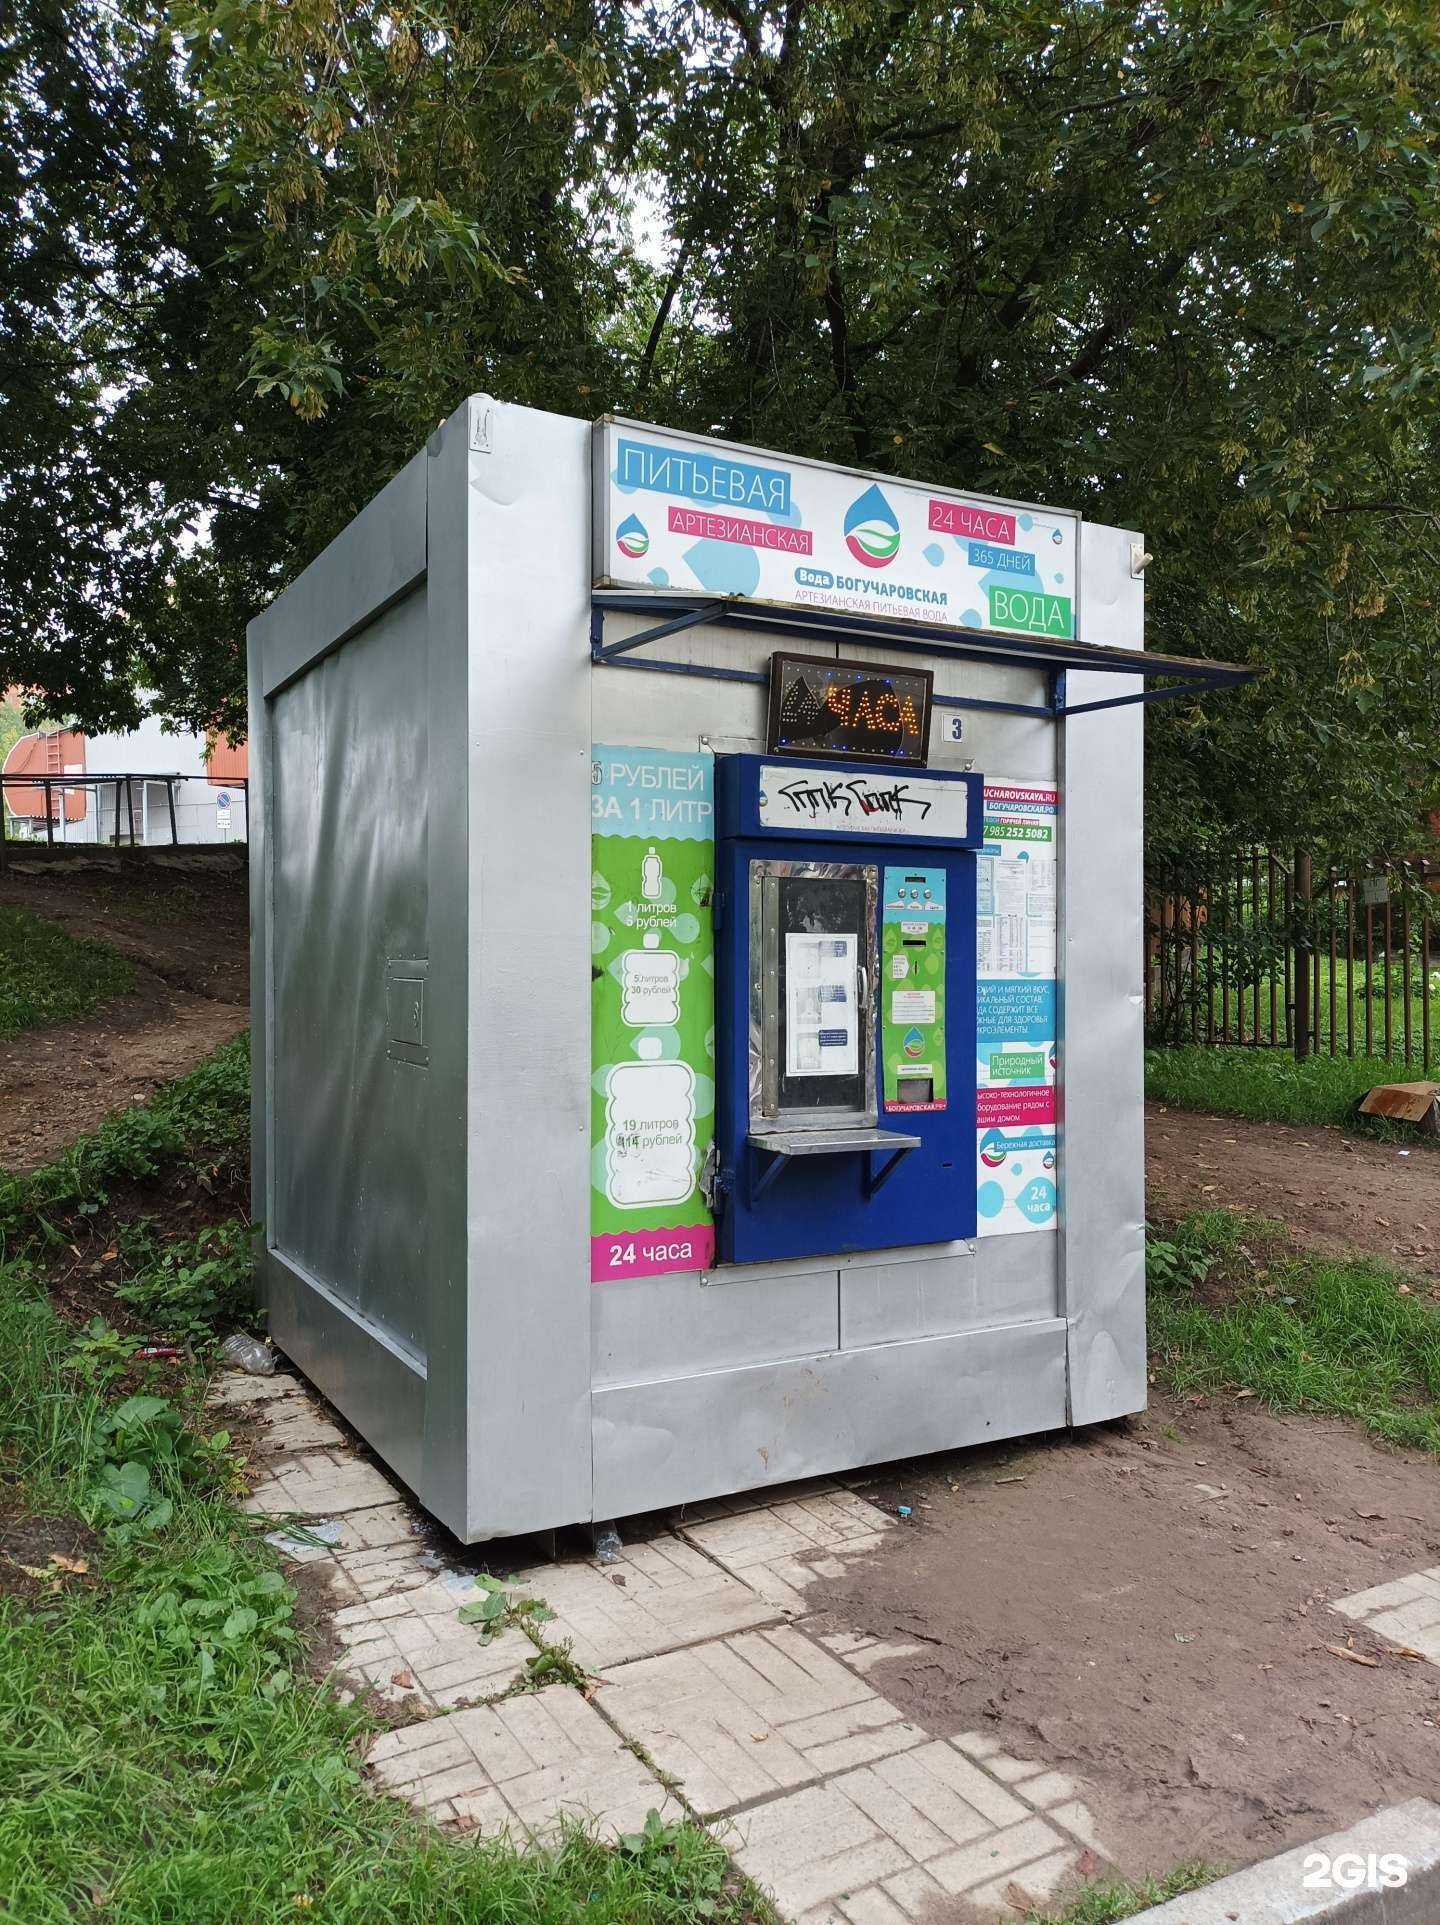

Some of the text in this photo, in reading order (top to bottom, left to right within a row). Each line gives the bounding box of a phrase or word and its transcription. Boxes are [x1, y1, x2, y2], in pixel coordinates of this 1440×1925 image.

[625, 448, 785, 510] ПИТЬЕВАЯ
[672, 512, 809, 553] АРТЕЗИАНСКАЯ
[932, 507, 1010, 540] 24 ЧАСА
[973, 549, 1031, 571] 365 ДНЕЙ
[800, 570, 948, 606] Вода БОГУЧАРОВСКАЯ
[795, 589, 948, 622] АРТЕЗИАНСКАЯ ПИТЬЕВАЯ ВОДА
[994, 591, 1065, 632] ВОДА
[952, 718, 962, 739] 3
[610, 763, 704, 791] РУБЛЕЙ
[591, 794, 712, 823] ЗА 1 ЛИТР
[1006, 827, 1024, 838] 252
[637, 903, 676, 915] литров
[636, 915, 677, 930] рублей
[641, 976, 669, 985] литров
[992, 1054, 1043, 1068] Природный
[992, 1067, 1031, 1076] источник
[1023, 1101, 1045, 1111] рядом
[623, 1120, 679, 1132] 19 литров
[642, 1133, 682, 1149] рублей
[1030, 1186, 1047, 1200] 24
[1027, 1202, 1050, 1213] часа
[609, 1242, 692, 1267] 24 часа
